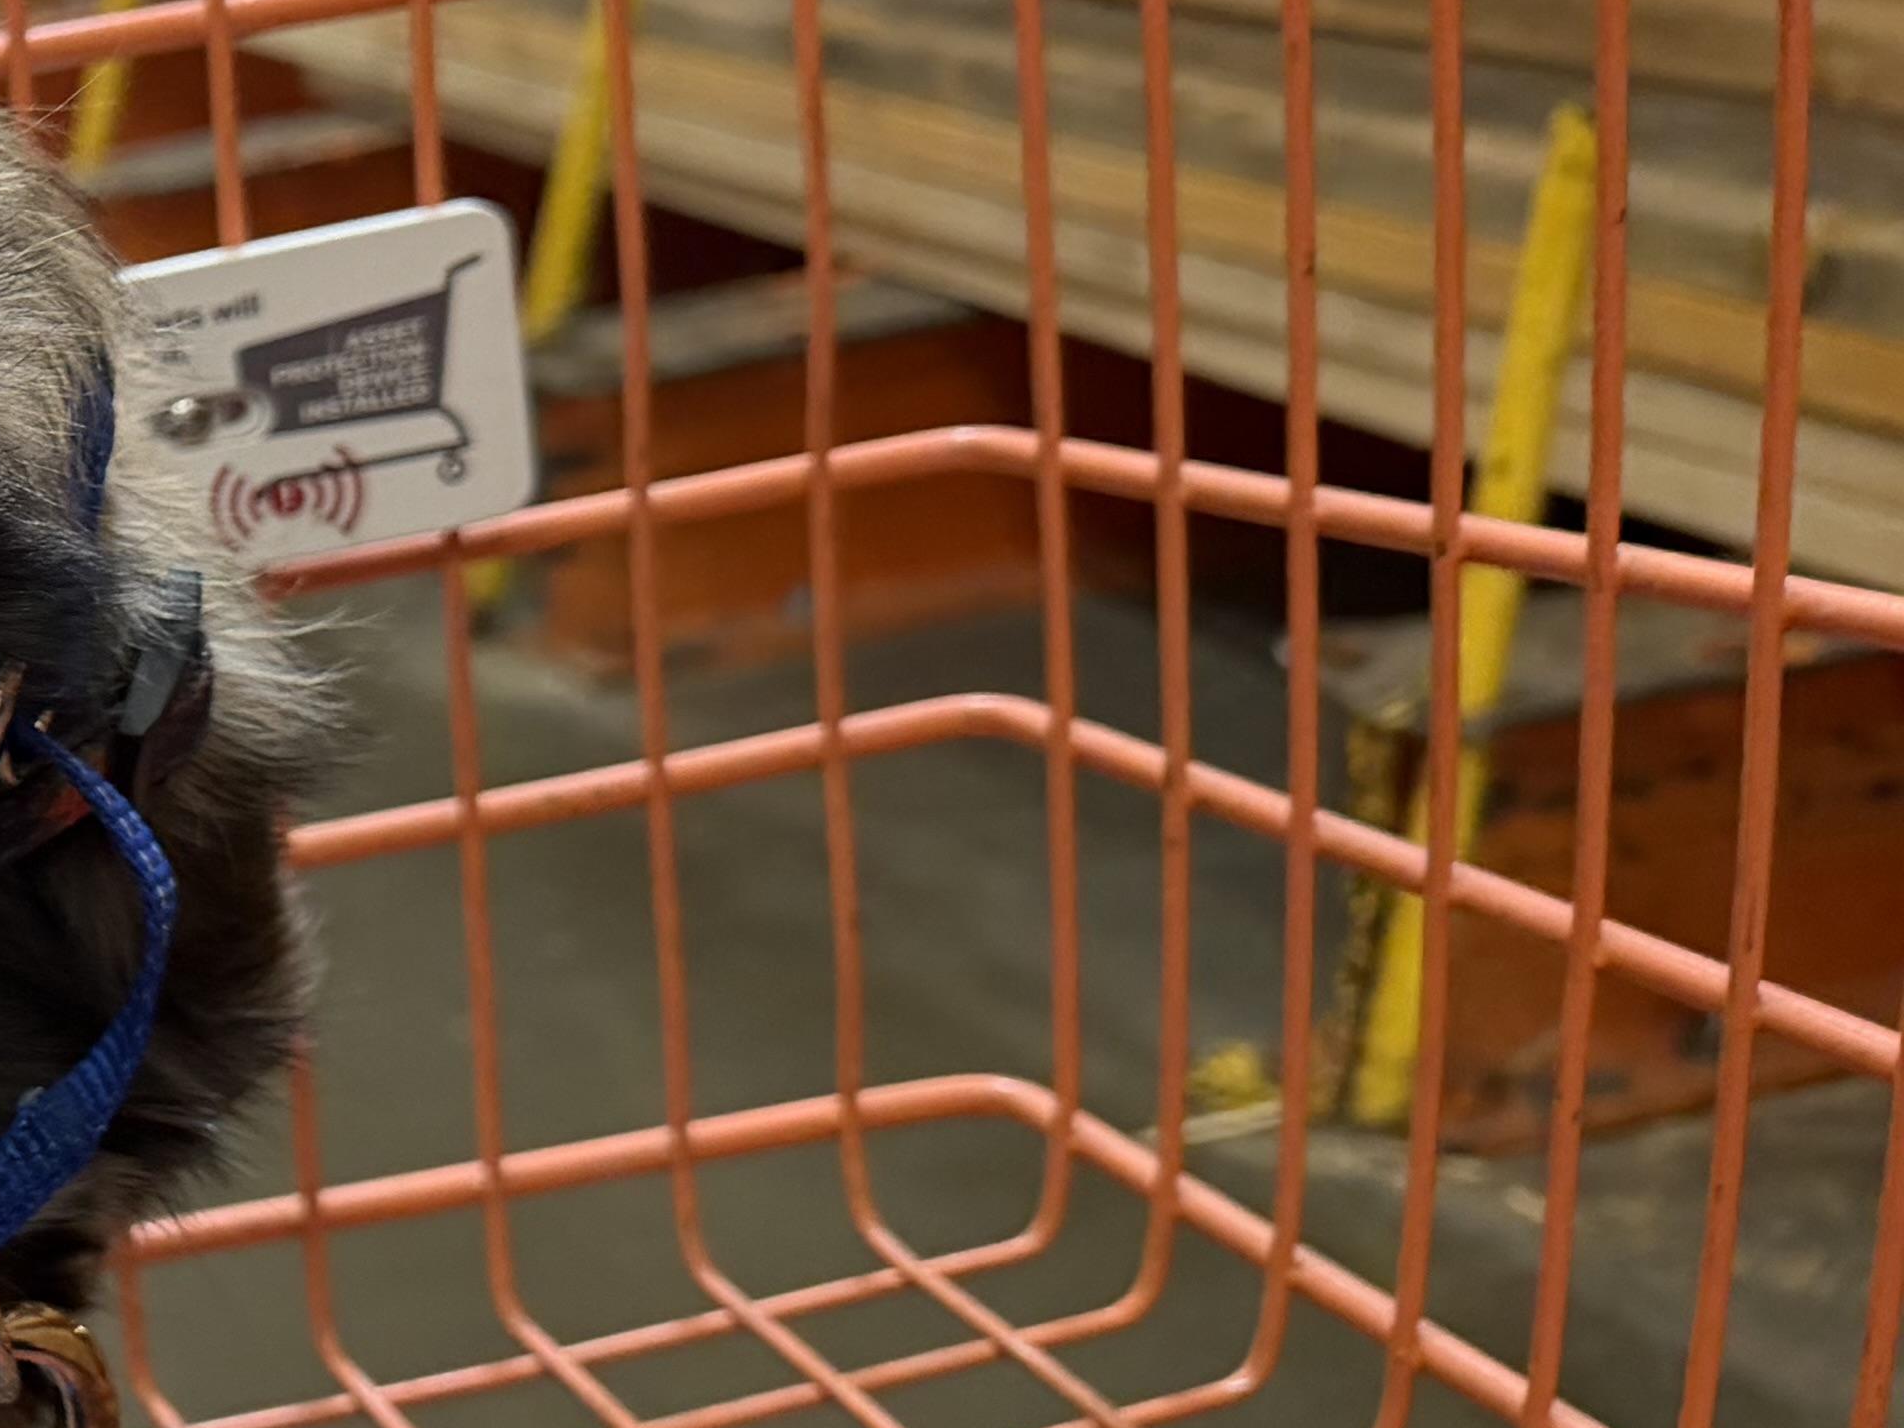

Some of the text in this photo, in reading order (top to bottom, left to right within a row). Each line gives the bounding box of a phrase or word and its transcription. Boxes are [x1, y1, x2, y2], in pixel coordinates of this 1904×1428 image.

[345, 314, 428, 348] ASSET
[269, 342, 430, 386] PROTECTION
[337, 367, 432, 398] DEVICE
[298, 383, 434, 424] INSTALLED
